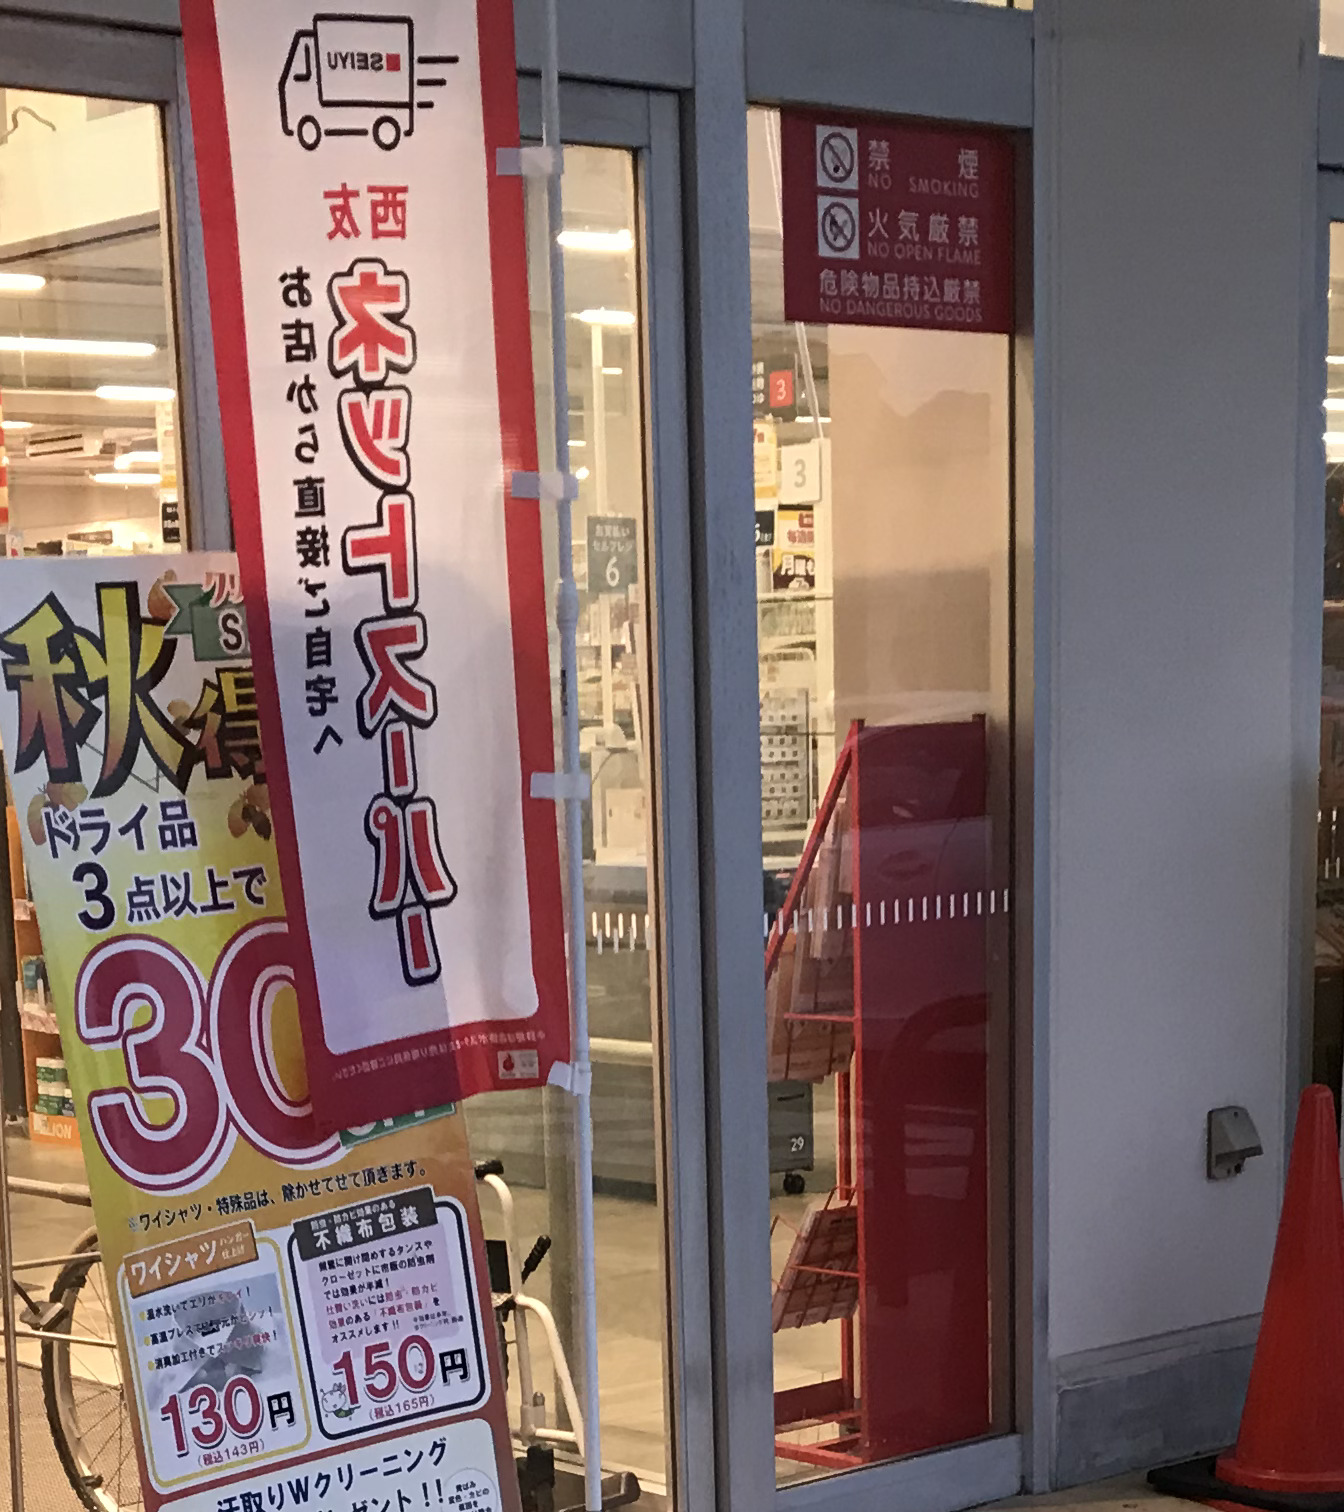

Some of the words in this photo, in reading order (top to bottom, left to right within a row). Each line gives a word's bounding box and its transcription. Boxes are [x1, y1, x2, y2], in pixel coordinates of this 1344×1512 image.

[867, 173, 892, 190] NO
[909, 176, 979, 198] SMOKING
[868, 208, 978, 247] 火気厳禁
[867, 241, 889, 256] NO
[894, 244, 932, 261] OPEN
[937, 248, 981, 266] FLAME
[819, 268, 980, 304] 危険物品持込厳禁
[820, 298, 840, 314] NO
[846, 301, 930, 320] DANGEROUS
[934, 306, 982, 322] GOODS
[777, 379, 786, 400] 3
[794, 459, 806, 488] 3
[606, 556, 620, 587] 6
[42, 799, 199, 859] ドライ品
[71, 861, 268, 932] 3点以上で
[790, 1136, 805, 1152] 29
[313, 1205, 419, 1250] 不織布包装
[130, 1240, 217, 1283] ワイシャツ
[368, 1395, 436, 1421] (税込165円)
[197, 1440, 265, 1467] (税込143円)
